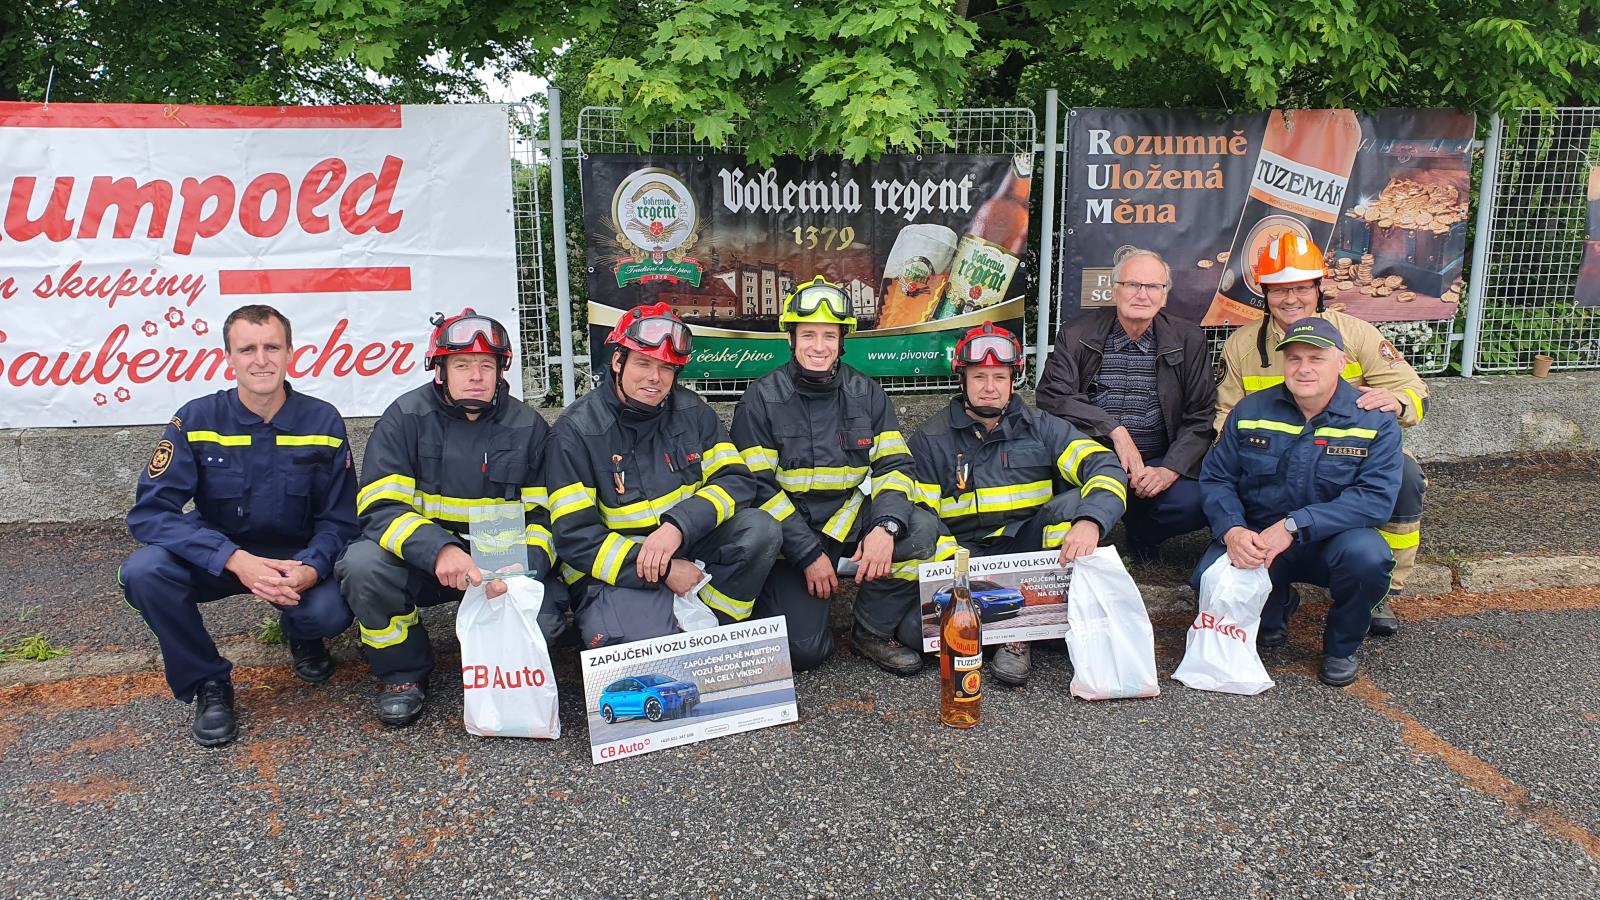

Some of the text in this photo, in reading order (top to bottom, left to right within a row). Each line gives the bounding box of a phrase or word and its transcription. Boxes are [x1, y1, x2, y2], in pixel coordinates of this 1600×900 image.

[1087, 129, 1248, 156] Rozumně
[1086, 162, 1225, 190] Uložená
[1256, 159, 1345, 207] TUZEMÁK
[0, 155, 404, 256] umpold
[717, 166, 973, 222] Bohemia regent
[636, 204, 677, 221] regent
[1084, 198, 1177, 224] Měna
[791, 225, 856, 252] 1379
[32, 260, 207, 308] skupiny
[0, 318, 416, 390] aubermcher
[696, 346, 742, 363] české
[735, 349, 775, 369] pivo
[982, 560, 1011, 571] VOZU
[1019, 575, 1056, 584] ZAPŮJČENÍ
[589, 649, 654, 667] ZAPŮJČENÍ
[655, 639, 687, 654] VOZU
[689, 632, 729, 648] ŠKODA
[730, 626, 767, 640] ENYAQ
[683, 643, 781, 669] ZAPŮJČENÍ PLNĚ NABITÉHO
[462, 664, 546, 690] CB Auto
[691, 665, 713, 678] VOZU
[714, 661, 741, 673] ŠKODA
[741, 656, 767, 669] ENYAQ
[704, 666, 763, 685] NA CELÝ VÍKEND
[600, 746, 616, 758] CB
[617, 742, 645, 755] Auto
